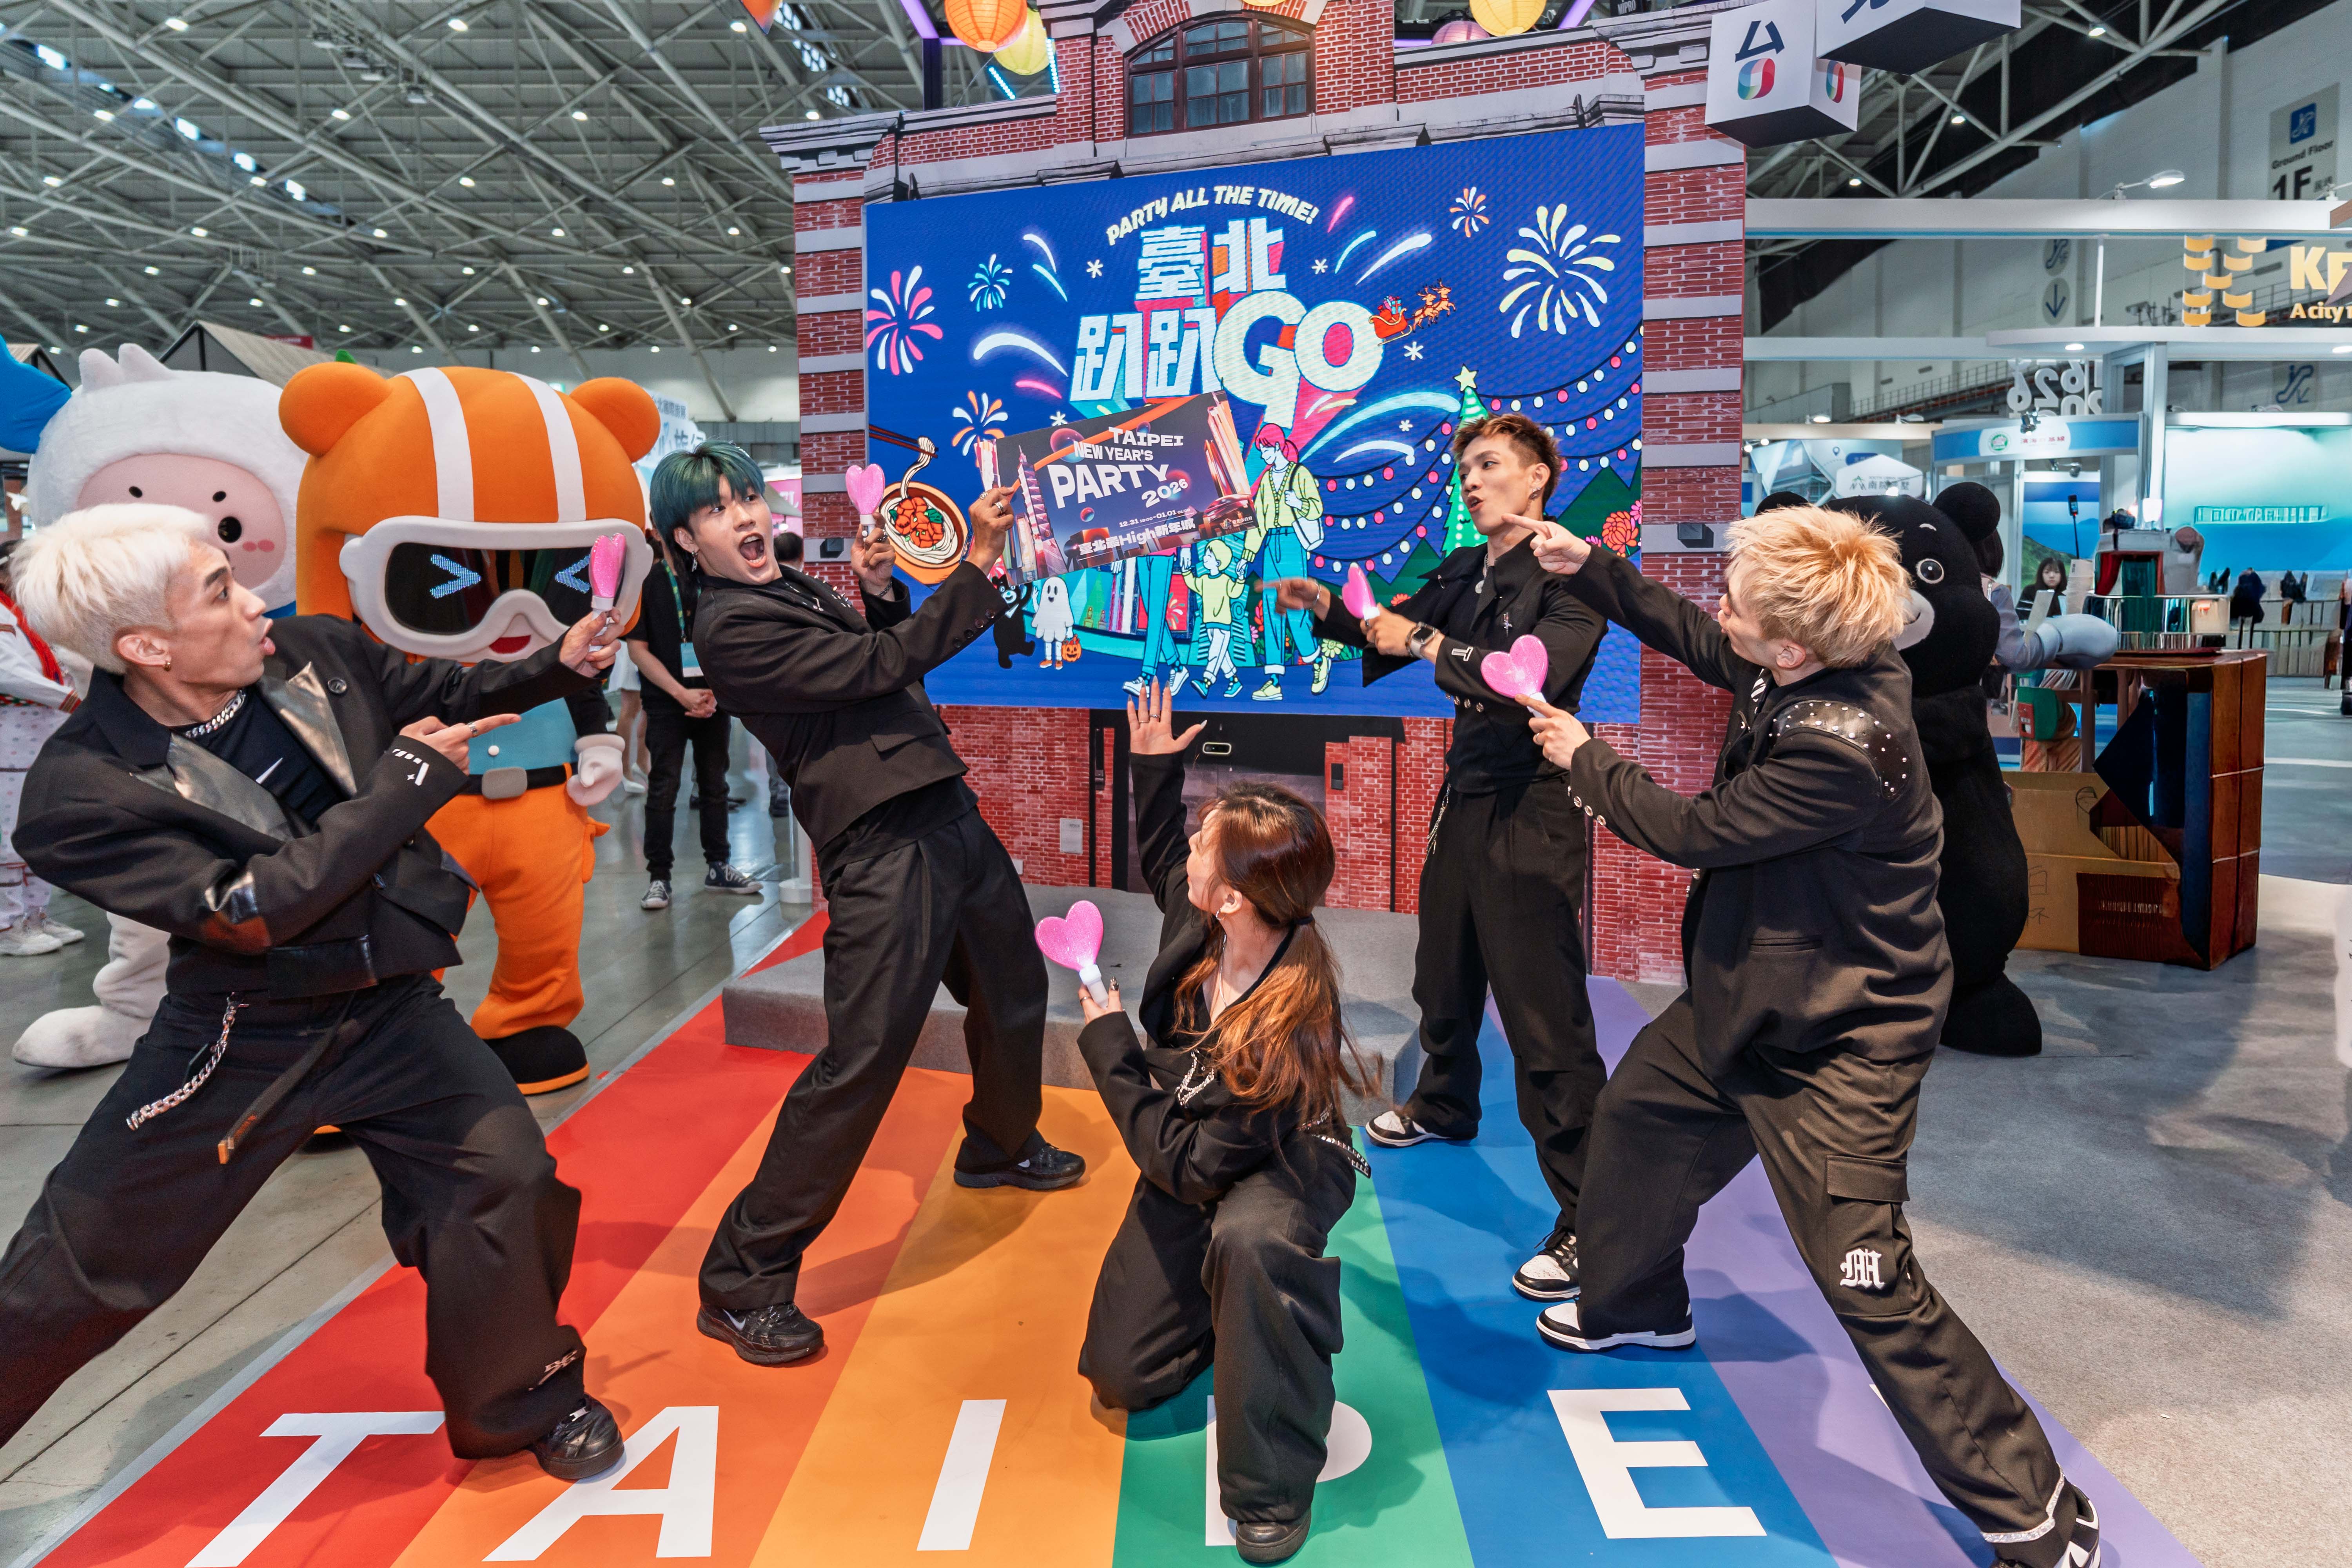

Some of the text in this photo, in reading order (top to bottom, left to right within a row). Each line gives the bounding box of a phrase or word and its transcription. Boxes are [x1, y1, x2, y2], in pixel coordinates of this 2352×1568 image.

[2272, 140, 2334, 169] Ground Floor
[2273, 165, 2312, 200] 1F
[1106, 185, 1320, 246] PARTY ALL THE TIME!
[1135, 216, 1287, 300] 臺北
[2290, 303, 2307, 319] A
[2307, 301, 2344, 323] city
[1074, 441, 1154, 462] NEW YEAR'S
[1109, 426, 1184, 448] TAIPEI
[1047, 464, 1169, 509] PARTY
[1142, 479, 1189, 508] 2026
[1119, 518, 1139, 528] 12.31
